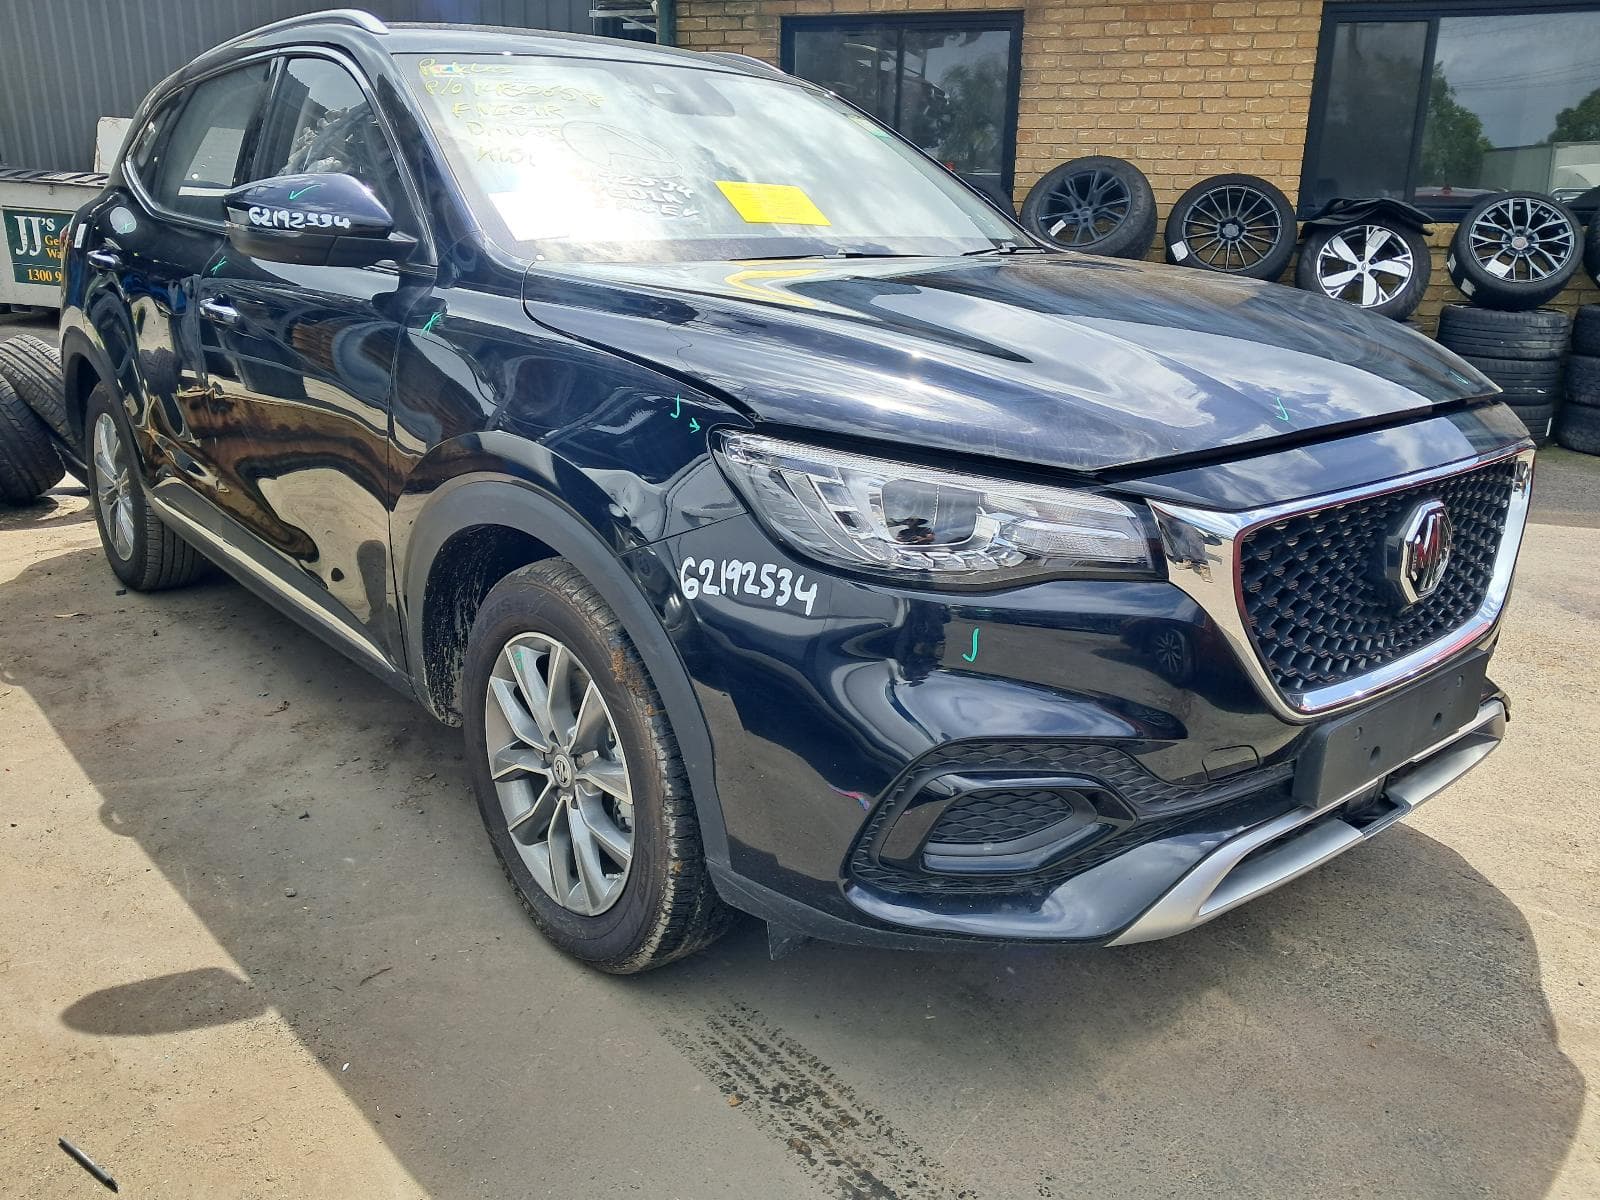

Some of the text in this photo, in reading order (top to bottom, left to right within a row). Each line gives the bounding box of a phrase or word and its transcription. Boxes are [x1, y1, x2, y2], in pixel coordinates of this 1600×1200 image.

[44, 234, 61, 246] Ge
[45, 247, 64, 259] Wa
[27, 269, 53, 282] 1300
[680, 556, 818, 616] 62192534
